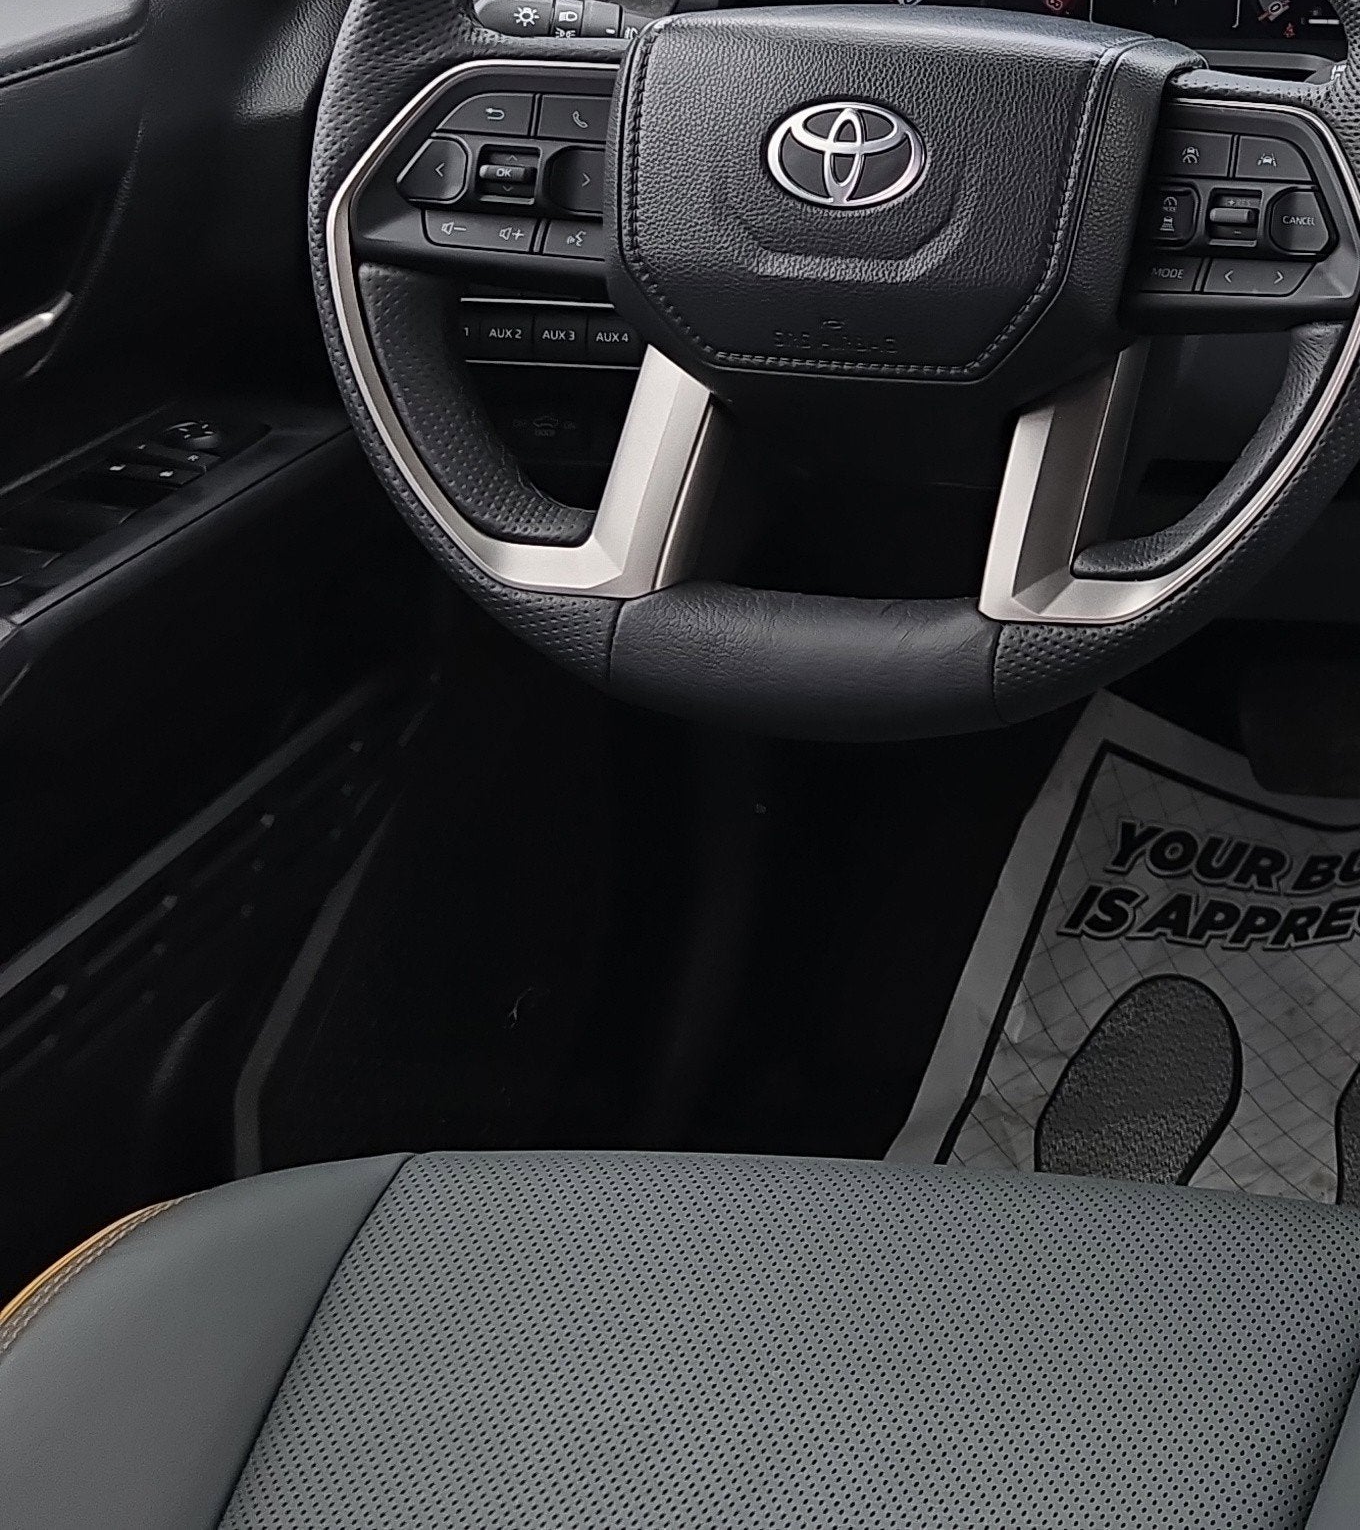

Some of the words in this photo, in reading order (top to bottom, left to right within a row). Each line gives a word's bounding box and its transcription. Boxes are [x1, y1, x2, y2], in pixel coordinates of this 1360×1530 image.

[1269, 1, 1283, 15] 0
[495, 167, 512, 178] OK
[1282, 216, 1316, 226] CANCEL
[1152, 268, 1184, 280] MODE
[464, 327, 470, 337] 1
[489, 328, 513, 339] AUX
[515, 329, 522, 339] 2
[542, 330, 566, 341] AUX
[568, 330, 576, 341] 3
[595, 332, 620, 343] AUX
[621, 332, 629, 343] 4
[1106, 820, 1290, 892] YOUR
[1056, 882, 1148, 938] IS
